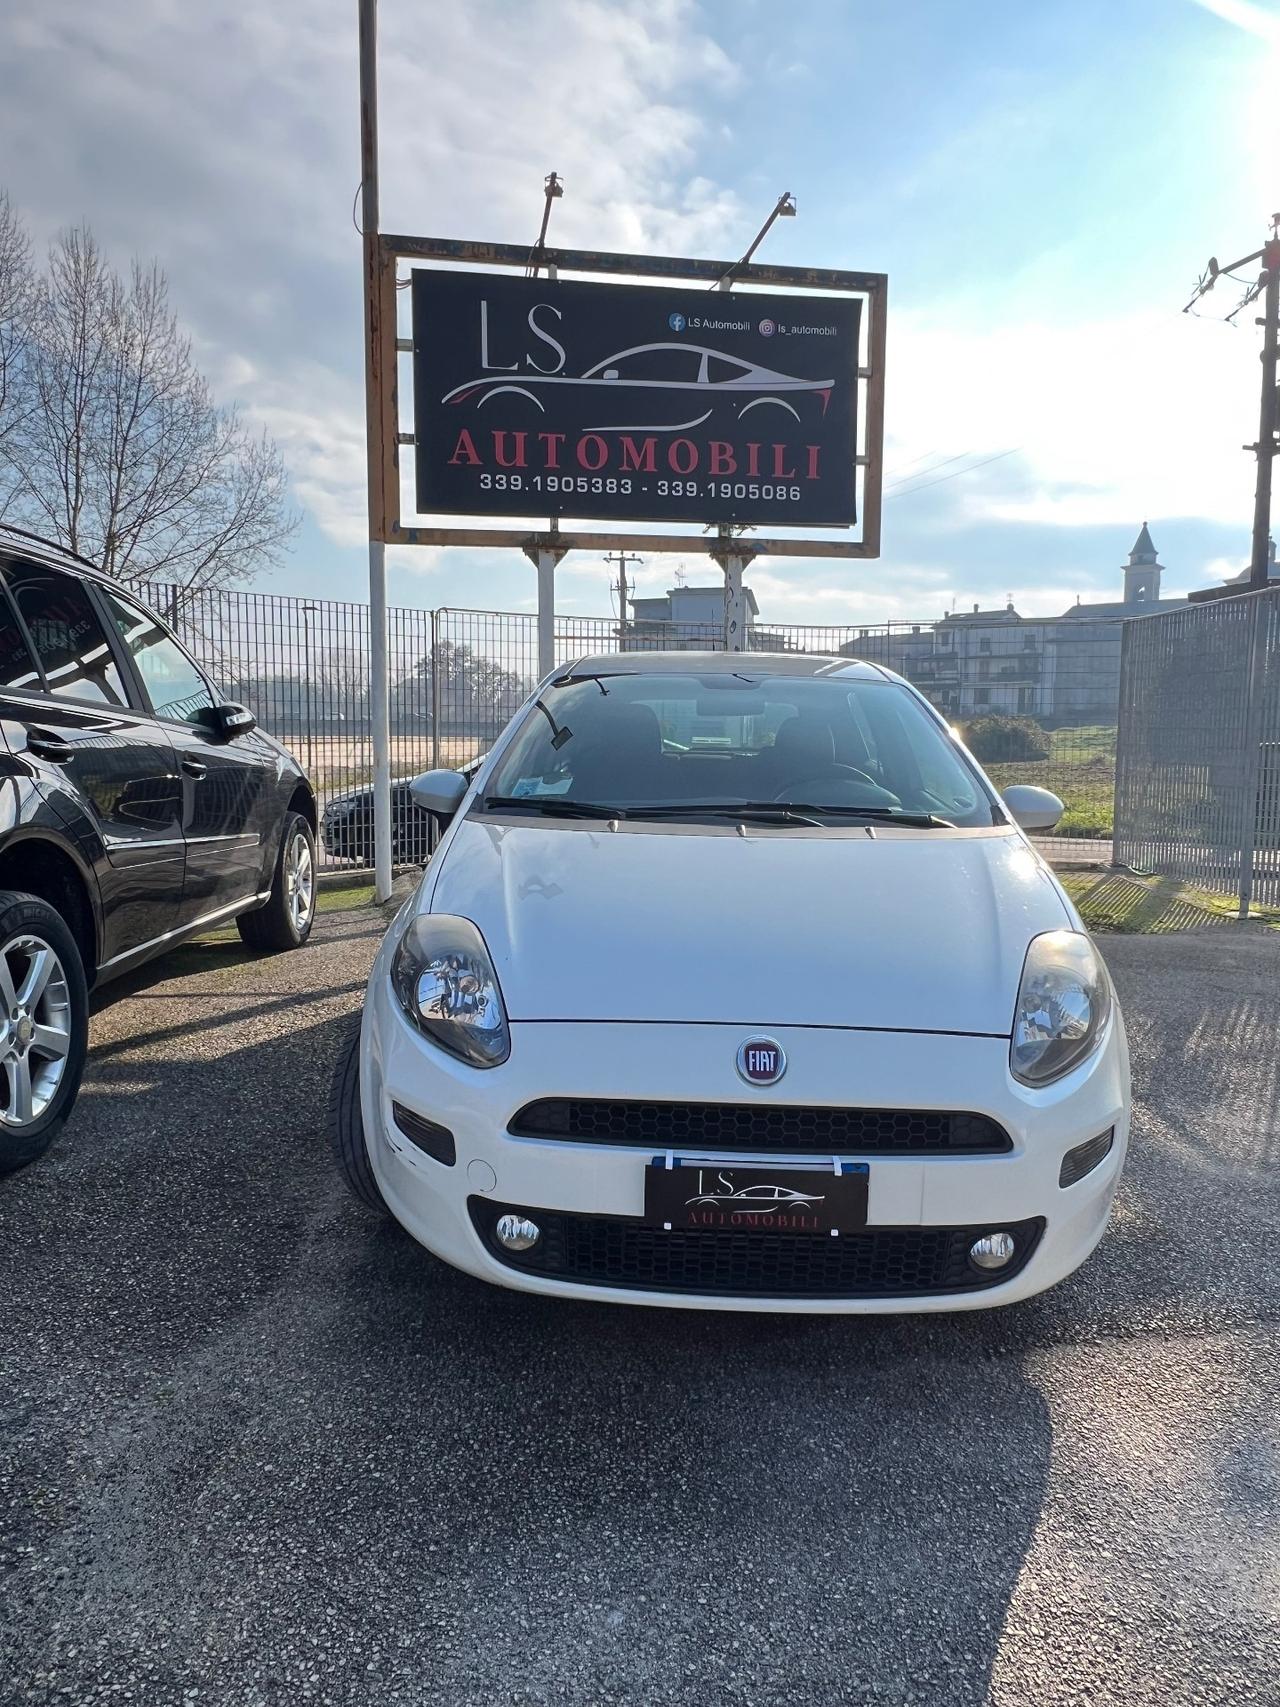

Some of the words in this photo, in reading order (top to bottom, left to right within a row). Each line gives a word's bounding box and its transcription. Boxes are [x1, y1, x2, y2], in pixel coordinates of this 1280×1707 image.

[688, 317, 701, 328] LS
[703, 319, 751, 331] Automobili
[777, 323, 837, 336] ls_automobili
[480, 300, 566, 374] LS
[447, 429, 822, 480] AUTOMOBILI
[479, 473, 633, 495] 339.1905383
[657, 480, 801, 501] 339.1905086
[748, 1050, 776, 1072] FIAT
[699, 1170, 735, 1195] LS
[688, 1211, 819, 1229] AUTOMOBILI
